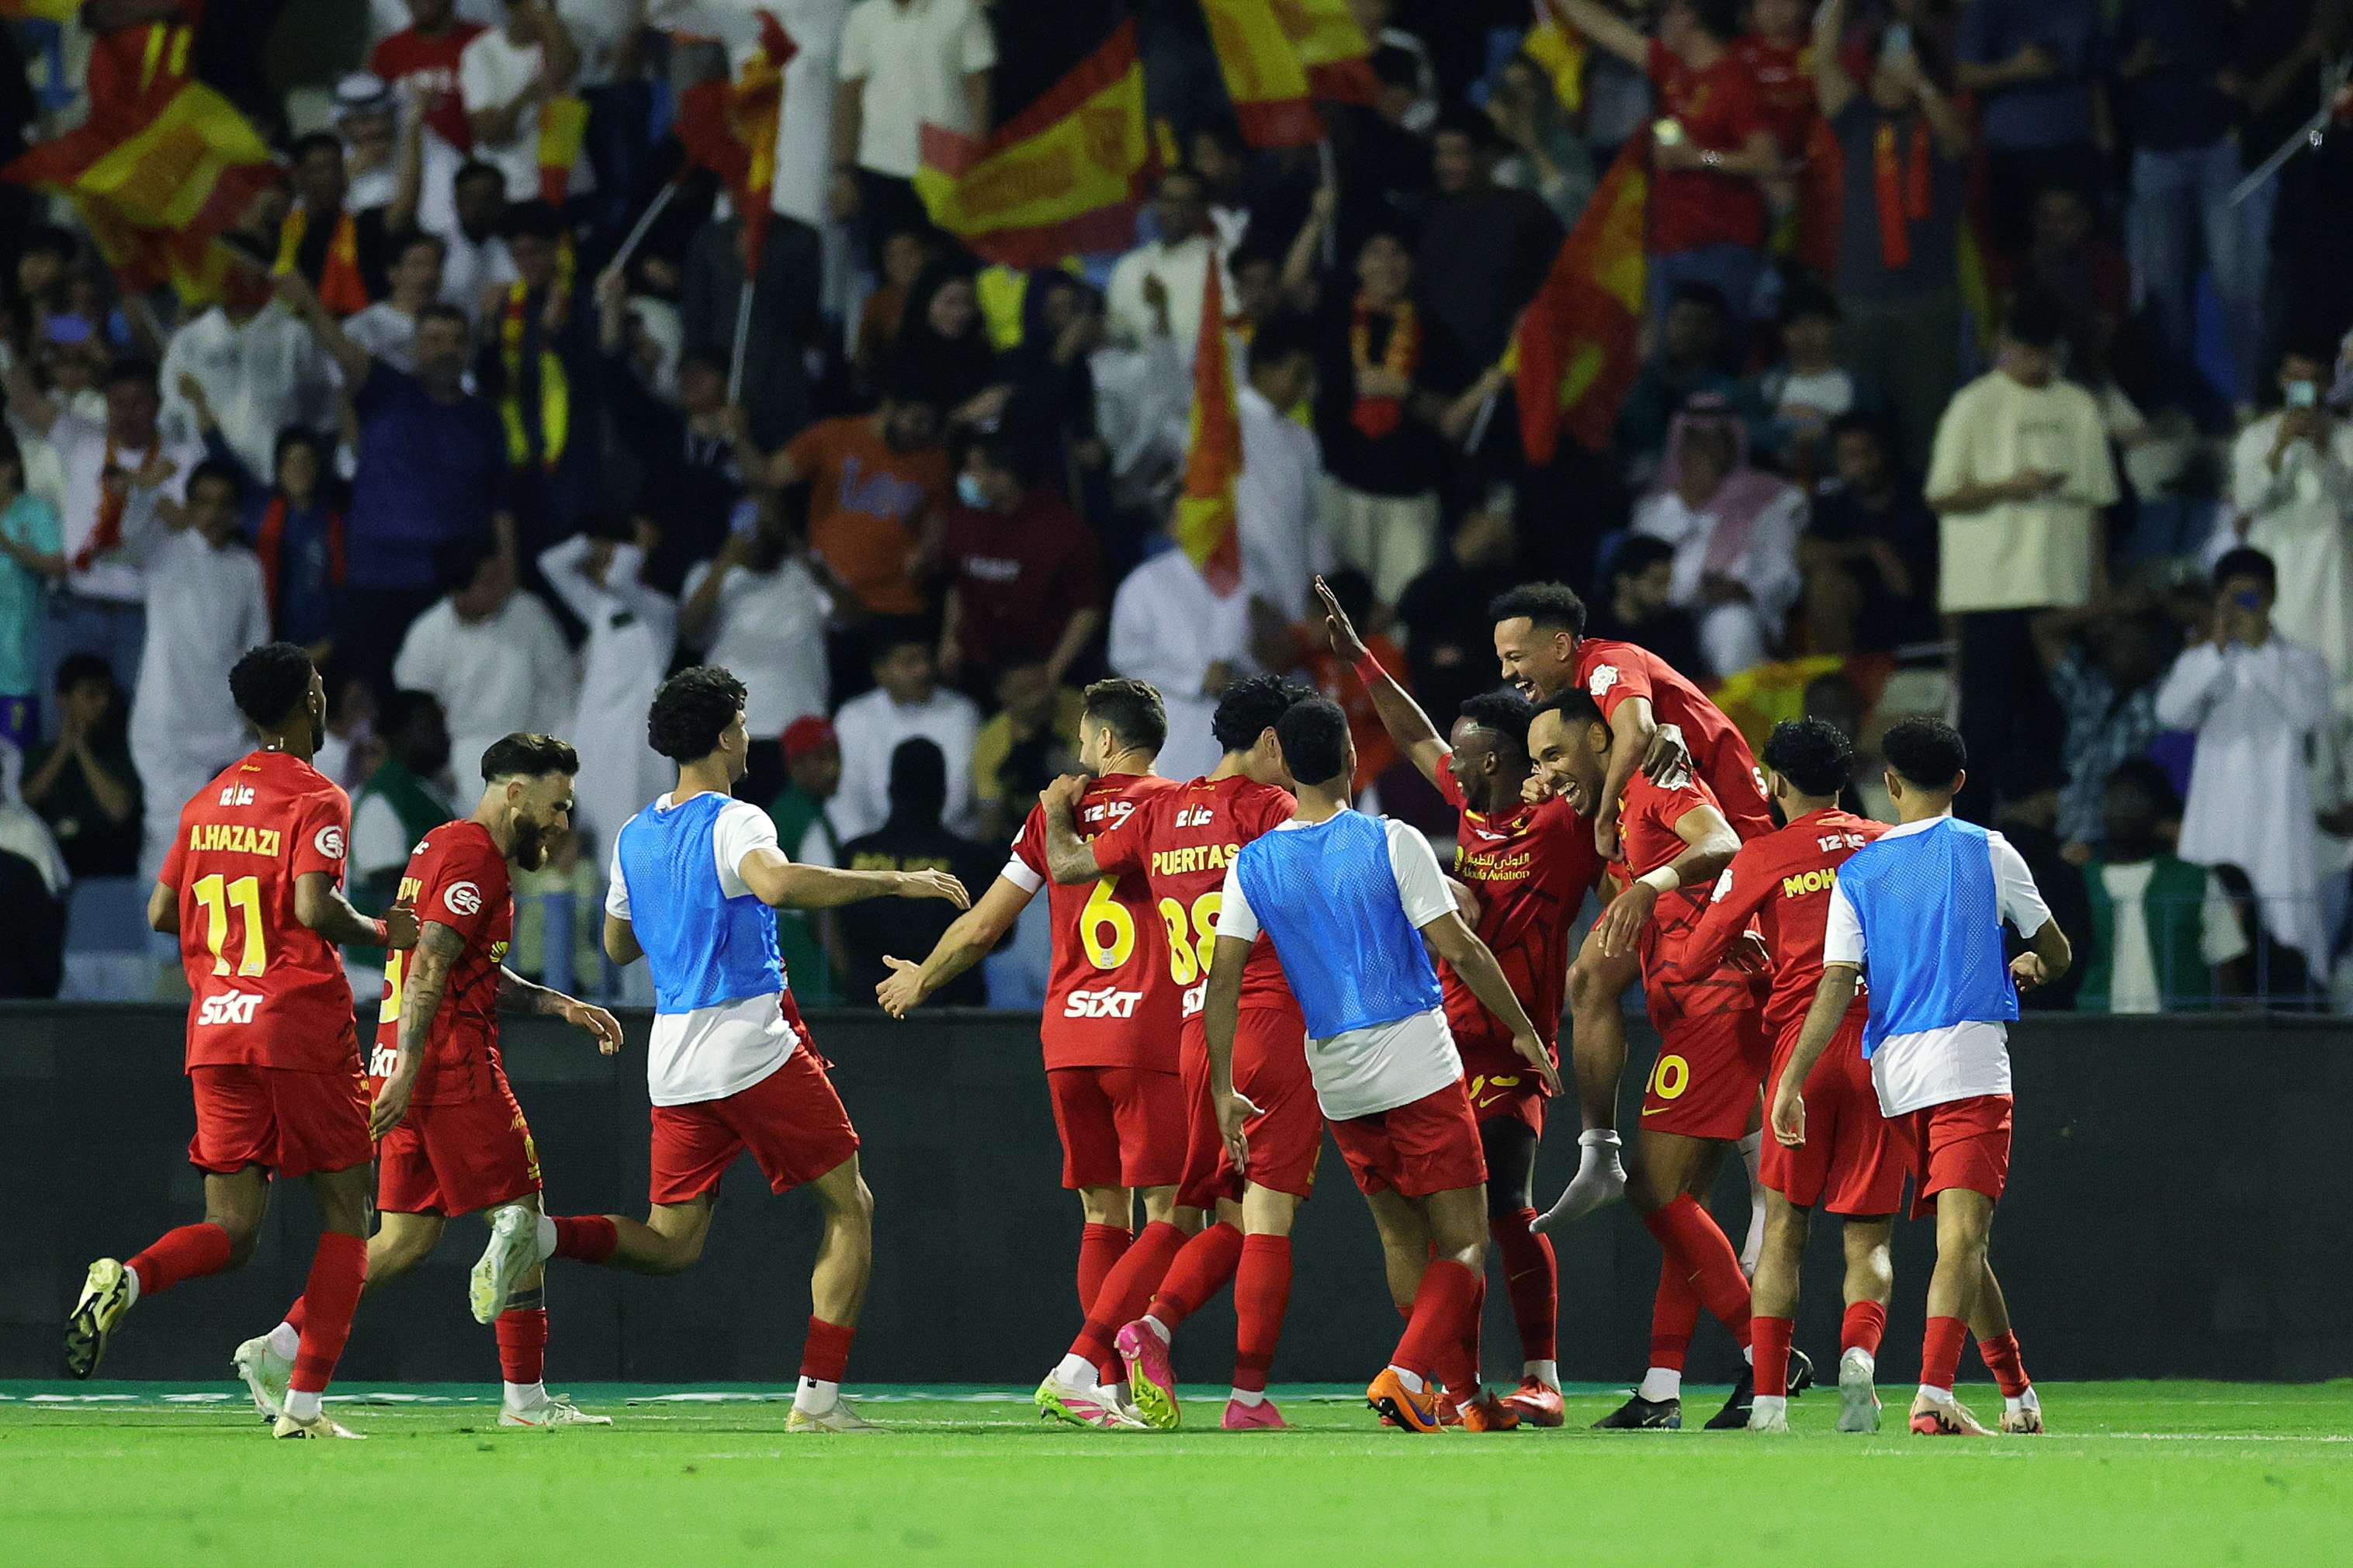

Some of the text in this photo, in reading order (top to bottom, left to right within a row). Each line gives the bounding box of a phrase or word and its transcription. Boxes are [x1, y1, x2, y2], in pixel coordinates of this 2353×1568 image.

[189, 824, 281, 857] A.HAZAZI
[1151, 843, 1241, 877] PUERTAS
[1487, 869, 1530, 881] Aviation
[192, 874, 266, 978] 11
[1079, 874, 1135, 970] 6
[198, 988, 264, 1025] SIXT
[1063, 986, 1143, 1018] SIXT
[369, 1042, 397, 1078] IXT
